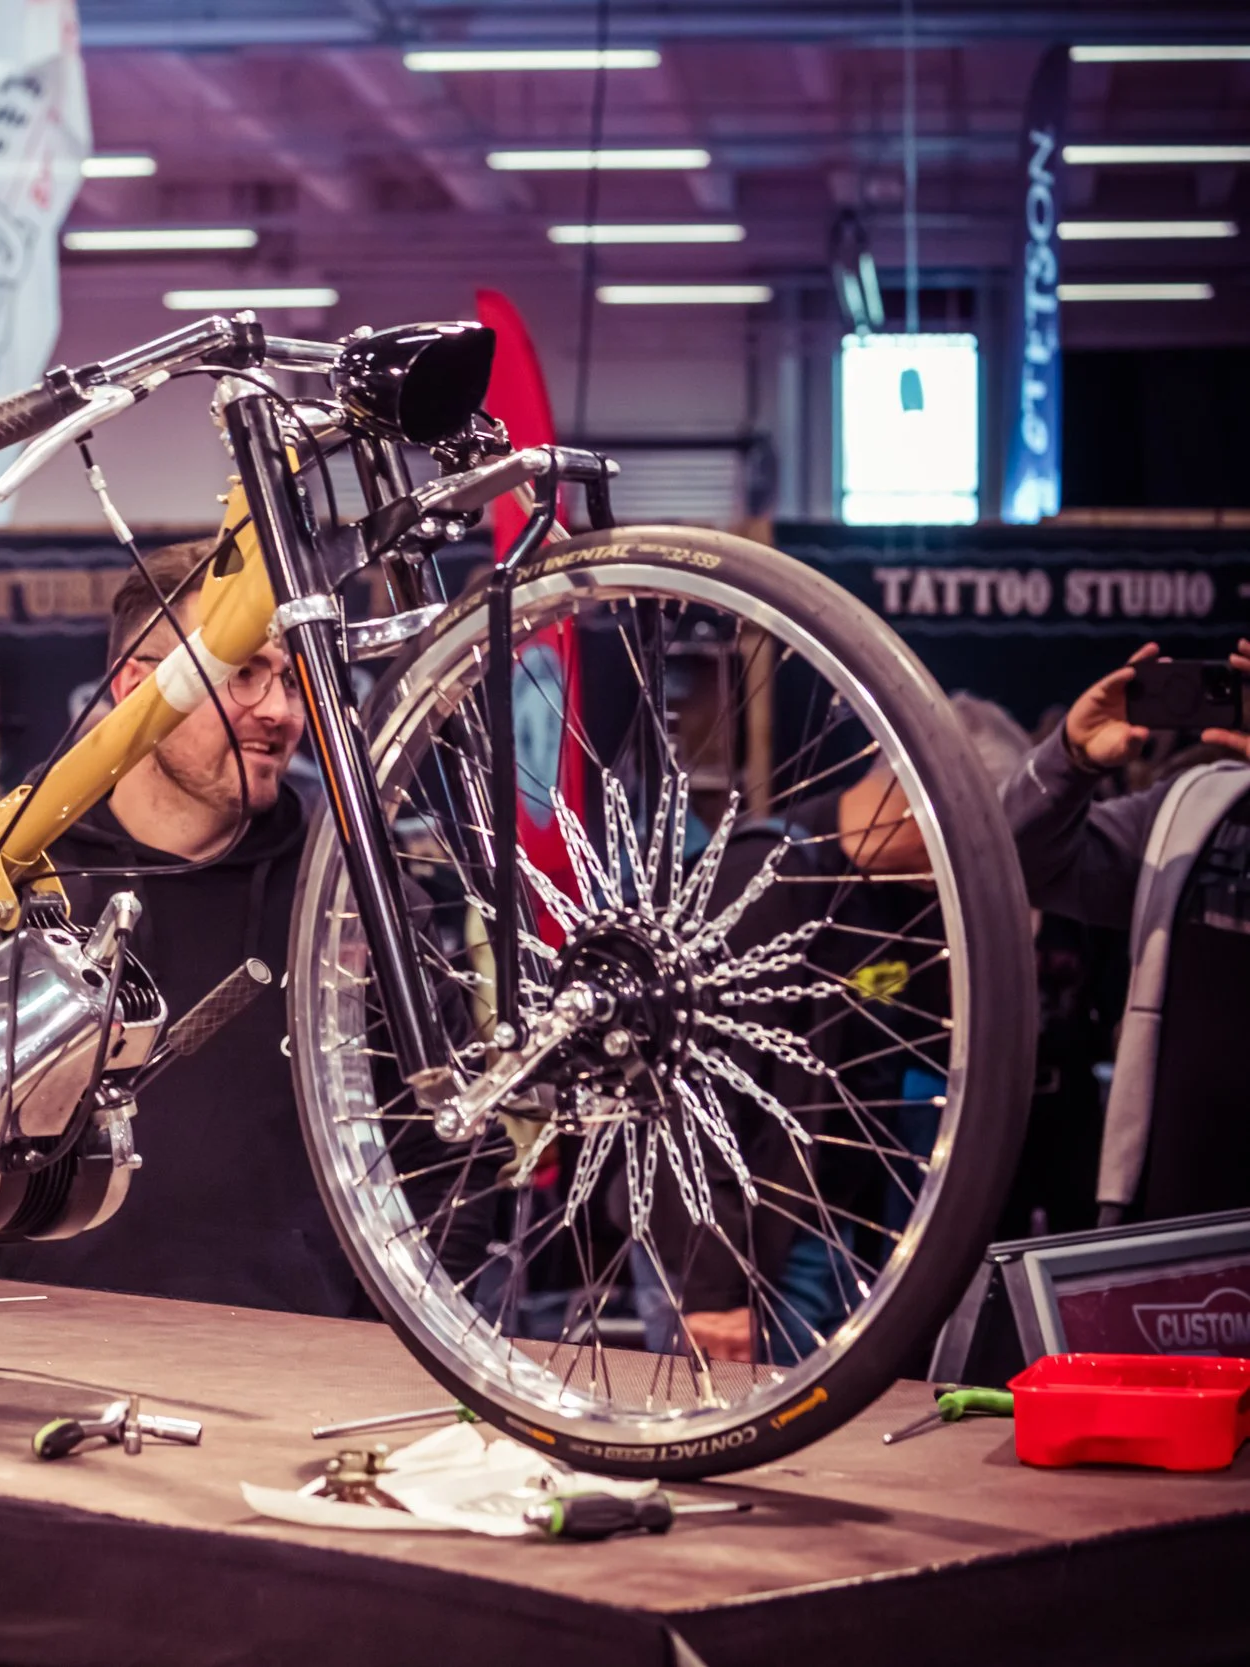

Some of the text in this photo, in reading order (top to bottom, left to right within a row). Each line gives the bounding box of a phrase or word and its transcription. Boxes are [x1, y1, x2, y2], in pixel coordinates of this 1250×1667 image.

[1022, 128, 1057, 454] STETSON
[873, 567, 1215, 617] TATTOO STUDIO
[660, 1425, 758, 1461] CONTACT
